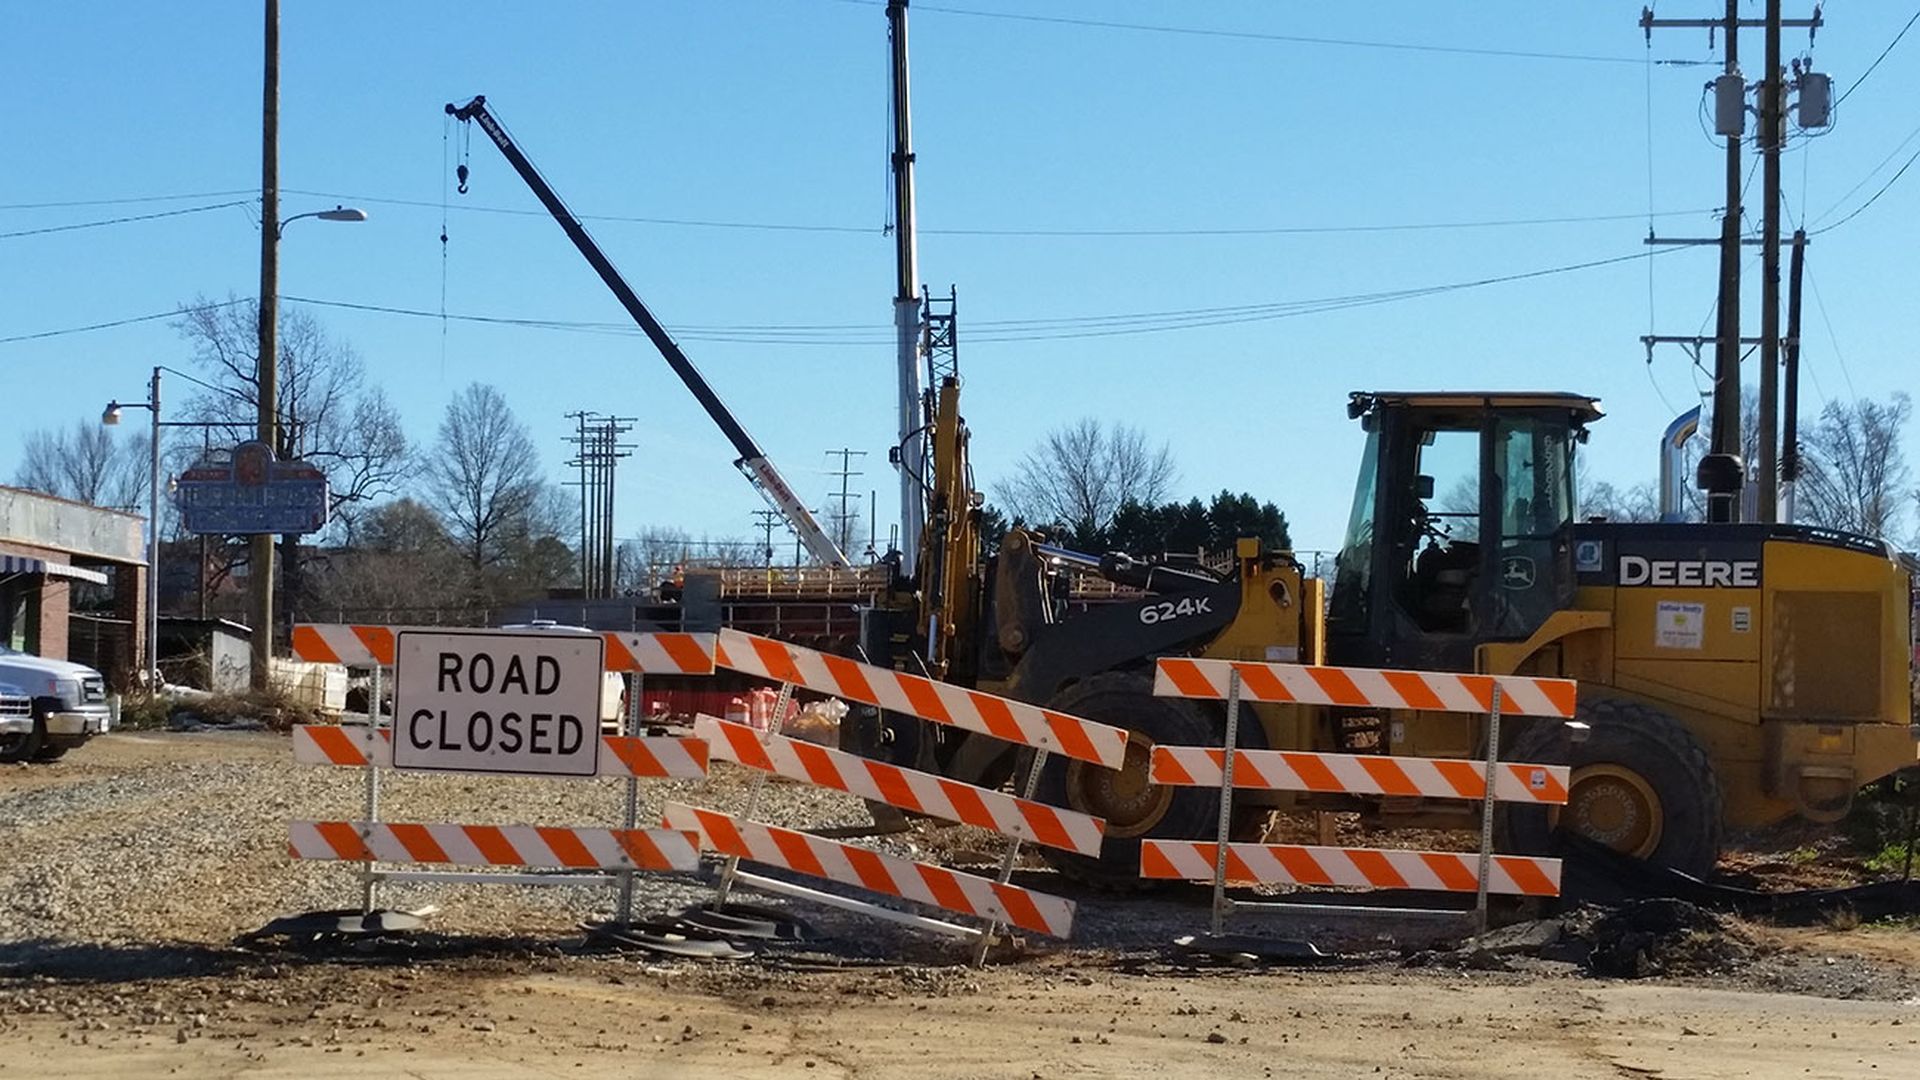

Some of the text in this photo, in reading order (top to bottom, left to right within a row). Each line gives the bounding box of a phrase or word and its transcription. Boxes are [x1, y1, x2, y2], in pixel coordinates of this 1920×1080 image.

[1619, 556, 1757, 586] DEERE
[1140, 597, 1212, 624] 624K
[438, 653, 561, 695] ROAD
[410, 708, 583, 755] CLOSED
